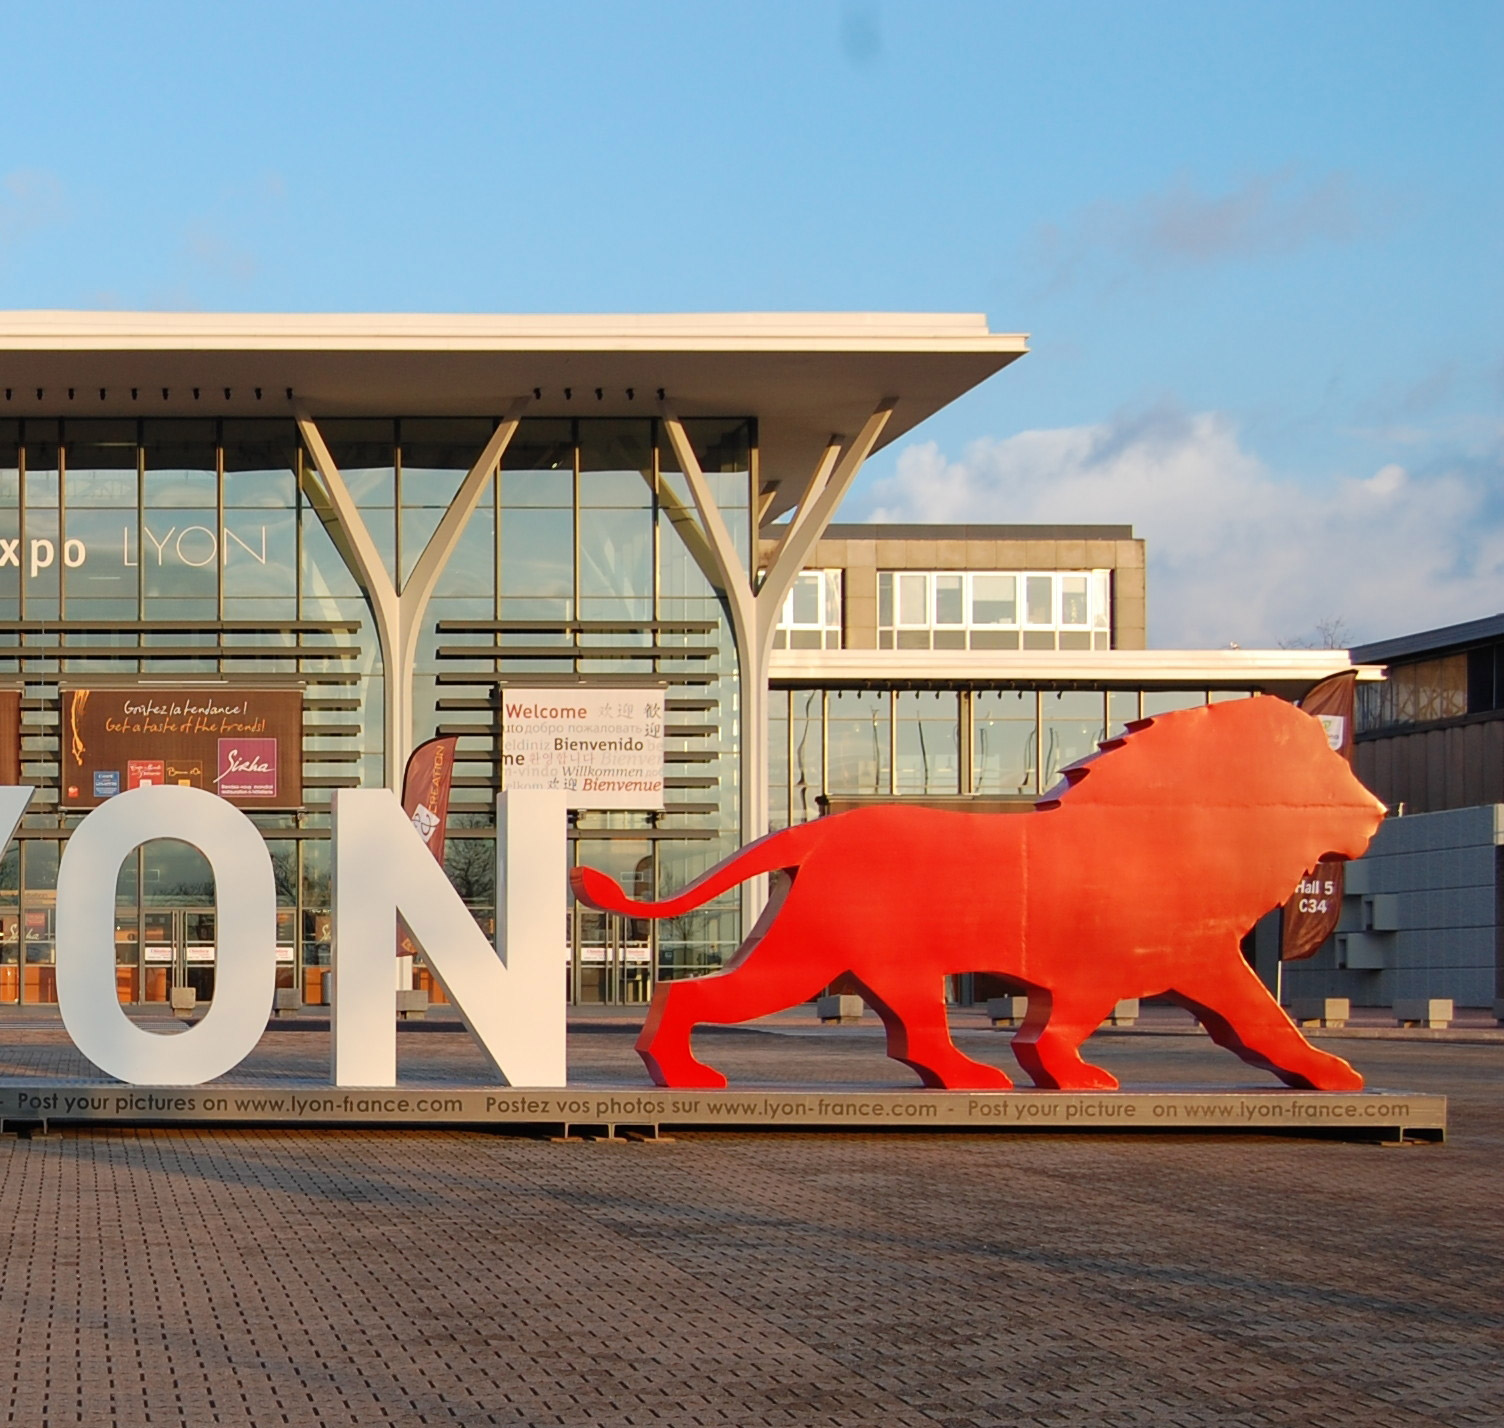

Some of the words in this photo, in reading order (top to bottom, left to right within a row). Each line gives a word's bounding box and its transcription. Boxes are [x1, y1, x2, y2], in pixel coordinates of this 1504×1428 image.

[124, 526, 266, 566] LYON
[506, 703, 587, 719] Welcome
[132, 723, 141, 732] a
[554, 737, 644, 751] Bienvenido
[562, 765, 643, 778] Willkommen
[582, 777, 662, 791] Bienvenue
[1324, 881, 1334, 895] 5
[1298, 898, 1328, 913] C34
[18, 1093, 58, 1110] Post
[64, 1096, 110, 1114] your
[116, 1093, 195, 1114] pictures
[203, 1098, 228, 1112] on
[486, 1097, 549, 1113] Postez
[557, 1100, 590, 1114] vos
[597, 1097, 665, 1118] photos
[672, 1100, 699, 1114] sur
[707, 1098, 938, 1119] www.lyon-france.com
[968, 1100, 1009, 1117] Post
[1015, 1104, 1060, 1121] your
[1066, 1100, 1136, 1121] picture
[1153, 1104, 1178, 1118] on
[1184, 1101, 1410, 1122] www.lyon-france.com
